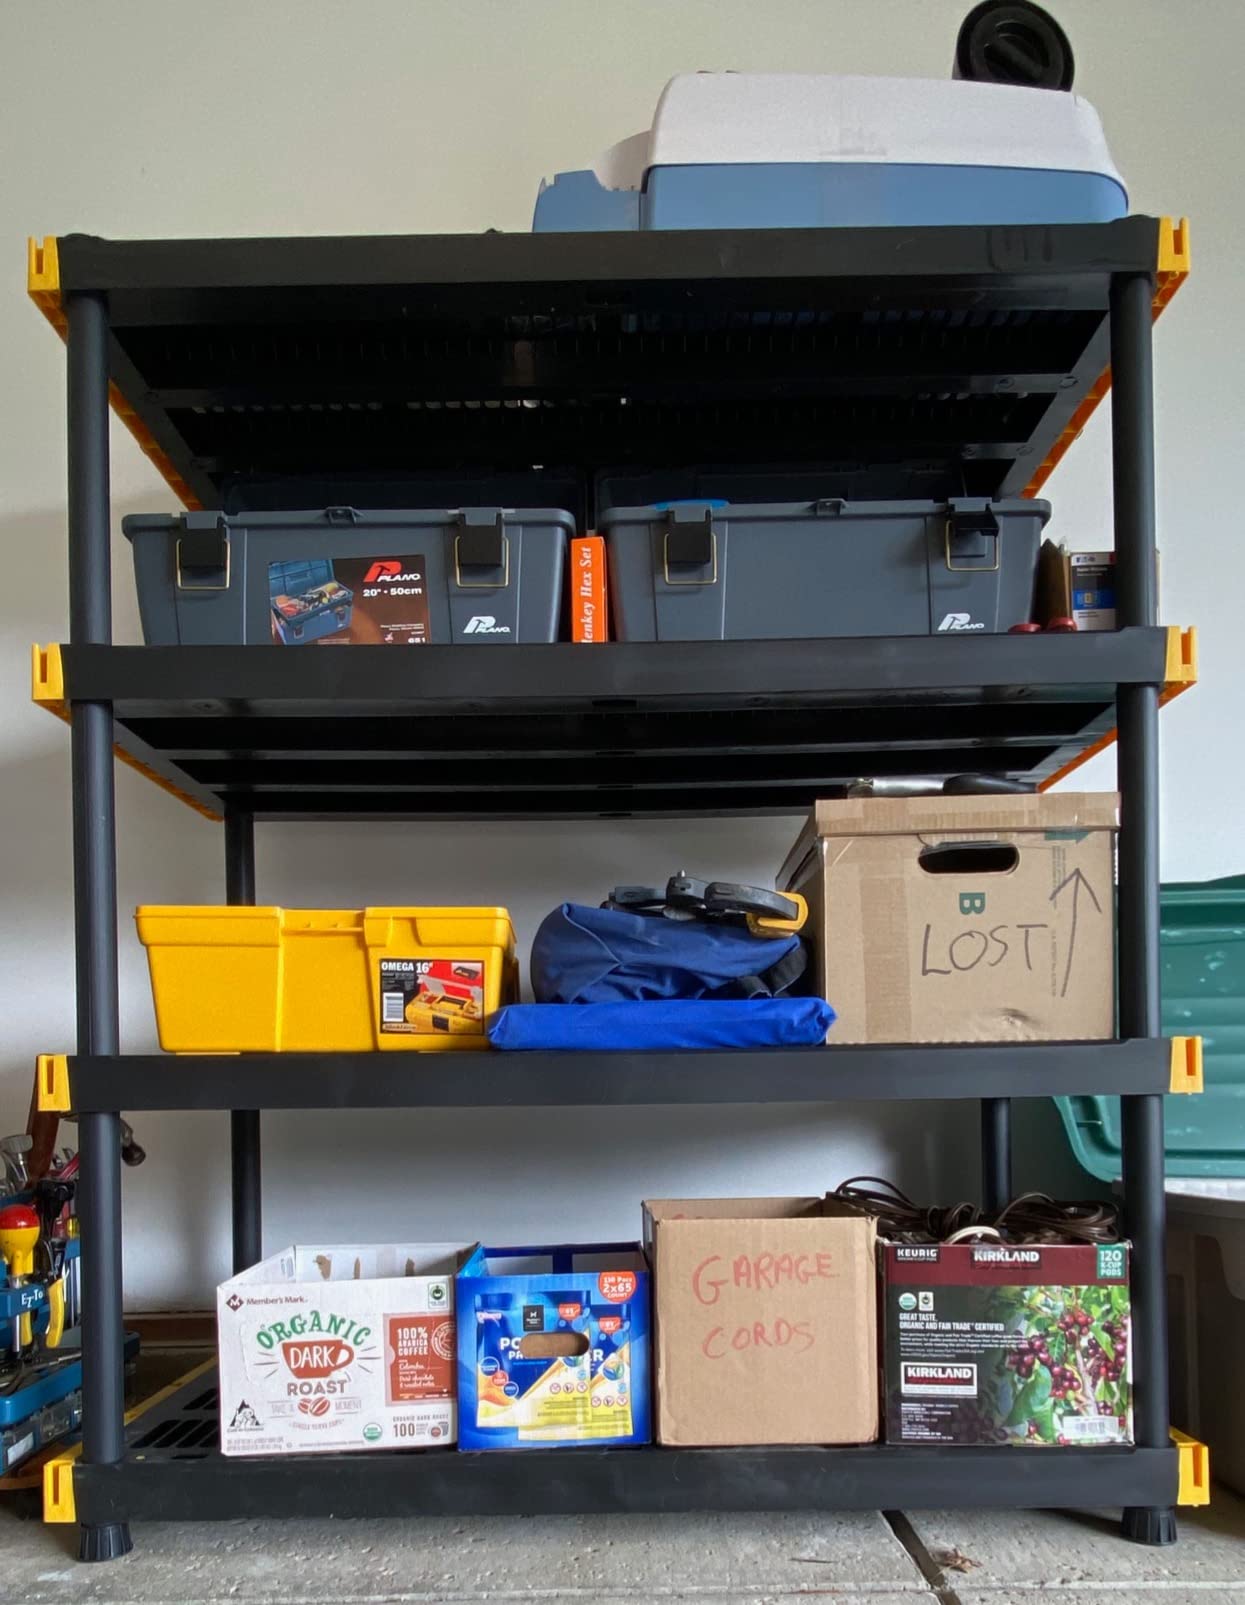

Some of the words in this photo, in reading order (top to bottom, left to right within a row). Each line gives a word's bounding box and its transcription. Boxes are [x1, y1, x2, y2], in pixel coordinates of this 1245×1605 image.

[580, 546, 592, 567] Set
[363, 561, 421, 583] PLANO
[390, 587, 422, 596] 50cm
[580, 571, 592, 598] Hex
[959, 892, 986, 915] B
[921, 923, 1048, 977] LOST
[381, 961, 414, 972] OMEGA
[897, 1248, 938, 1257] KEURIG
[974, 1250, 1040, 1262] KIRKLAND
[1100, 1250, 1122, 1262] 120
[692, 1253, 839, 1306] GARAGE
[603, 1282, 632, 1293] 2x65
[246, 1298, 284, 1306] Member's
[256, 1310, 372, 1350] ORGANIC
[899, 1321, 925, 1329] ORGANIC
[925, 1322, 938, 1330] AND
[938, 1322, 951, 1330] FAIR
[975, 1323, 1004, 1331] CERTIFIED
[397, 1327, 429, 1340] 100%
[702, 1317, 816, 1360] CORDS
[290, 1345, 336, 1369] DARK
[398, 1347, 429, 1356] COFFEE
[907, 1366, 972, 1379] KIRKLAND
[287, 1380, 348, 1396] ROAST
[393, 1422, 415, 1438] 100
